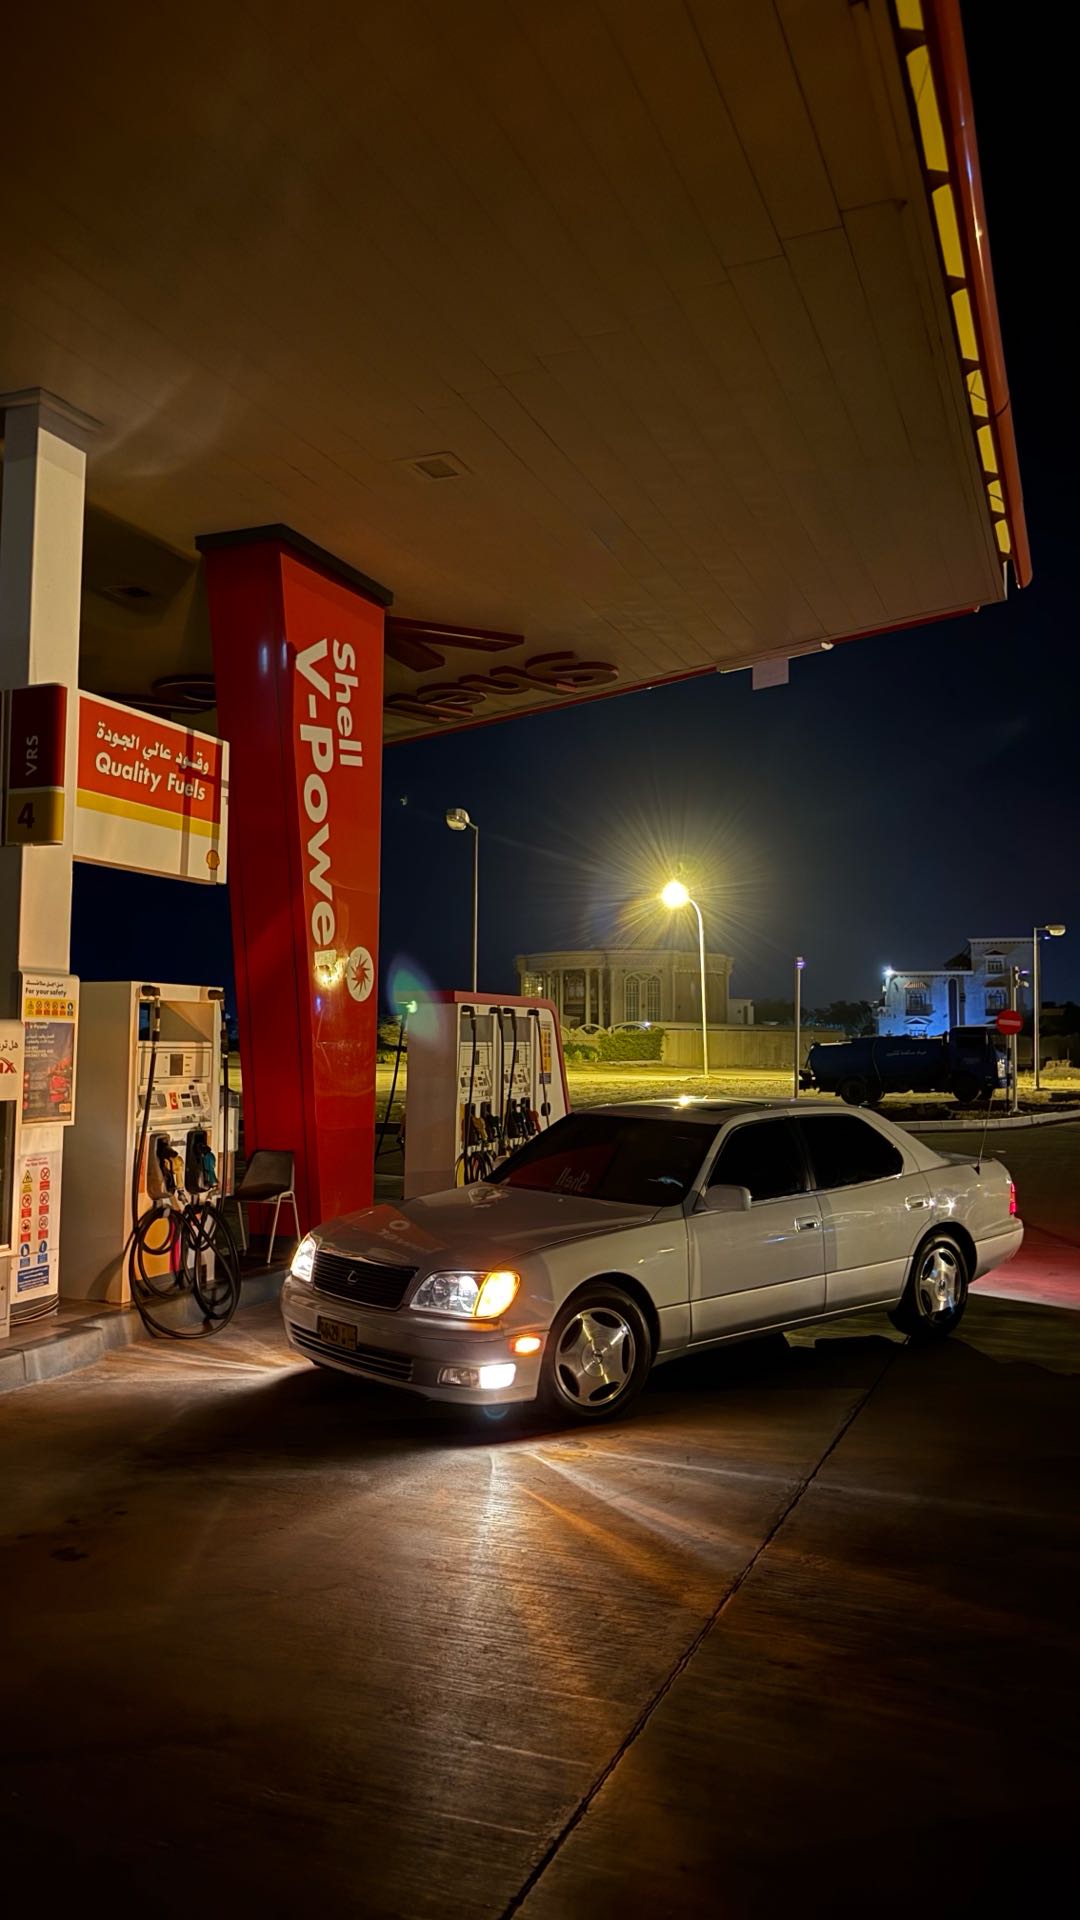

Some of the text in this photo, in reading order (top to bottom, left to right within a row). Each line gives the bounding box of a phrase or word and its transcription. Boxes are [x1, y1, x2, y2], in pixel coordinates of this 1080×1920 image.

[333, 639, 363, 767] Shell
[96, 721, 140, 751] الجودة
[142, 742, 171, 760] عالي
[25, 735, 39, 777] VRS
[95, 752, 206, 801] Quality Fuels
[17, 802, 35, 829] 4
[295, 638, 337, 979] V-Power
[35, 989, 49, 997] your
[50, 988, 67, 998] safety
[8, 1039, 19, 1051] هل
